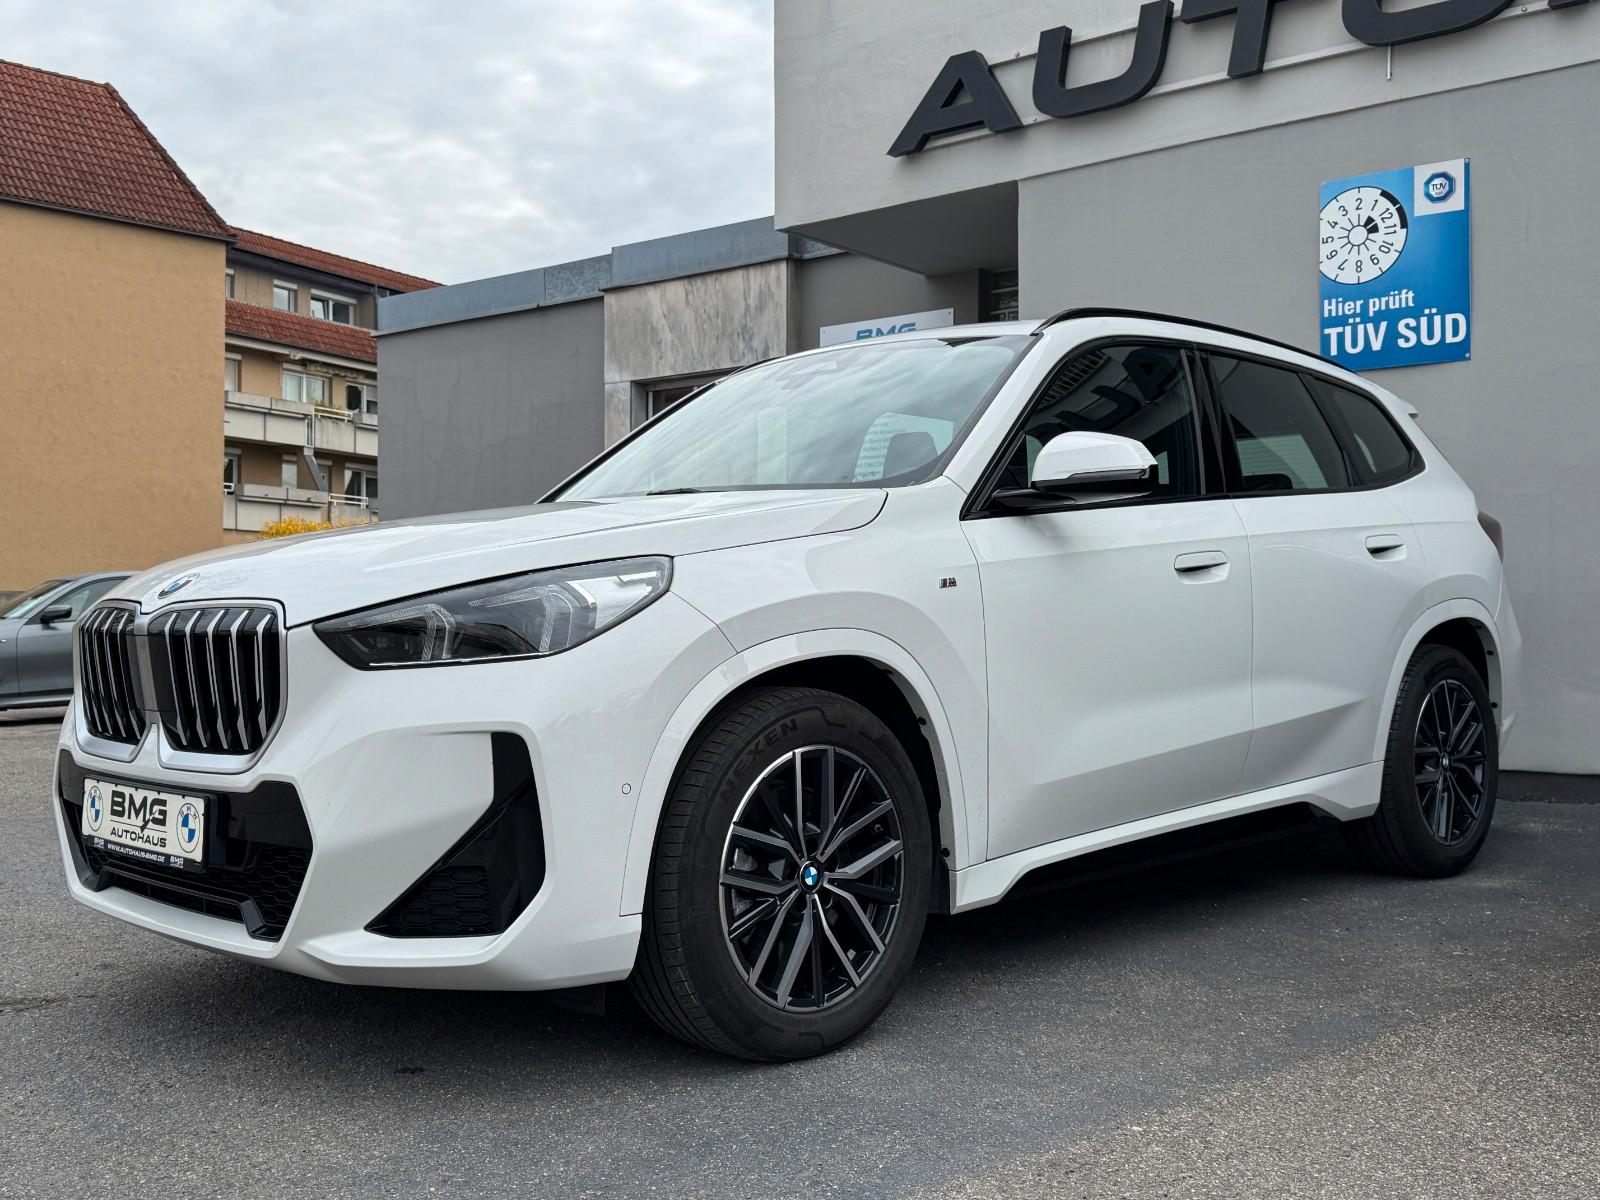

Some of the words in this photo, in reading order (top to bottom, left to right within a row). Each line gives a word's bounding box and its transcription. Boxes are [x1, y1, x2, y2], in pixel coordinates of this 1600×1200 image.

[1356, 197, 1362, 210] 2
[1371, 199, 1379, 211] 1
[1338, 205, 1348, 216] 3
[1379, 207, 1394, 223] 12
[1327, 220, 1338, 229] 4
[1383, 223, 1397, 236] 11
[1322, 235, 1334, 244] 5
[1378, 240, 1394, 254] 10
[1326, 249, 1338, 260] 6
[1370, 253, 1380, 266] 9
[1338, 259, 1349, 271] 7
[1355, 260, 1362, 273] 8
[1323, 298, 1363, 317] Hier
[1368, 289, 1414, 317] prüft
[1324, 317, 1388, 356] TÜV
[1397, 307, 1467, 349] SÜD
[719, 717, 798, 801] NEXEN
[110, 789, 167, 828] BMG
[110, 826, 167, 848] AUTOHAUS
